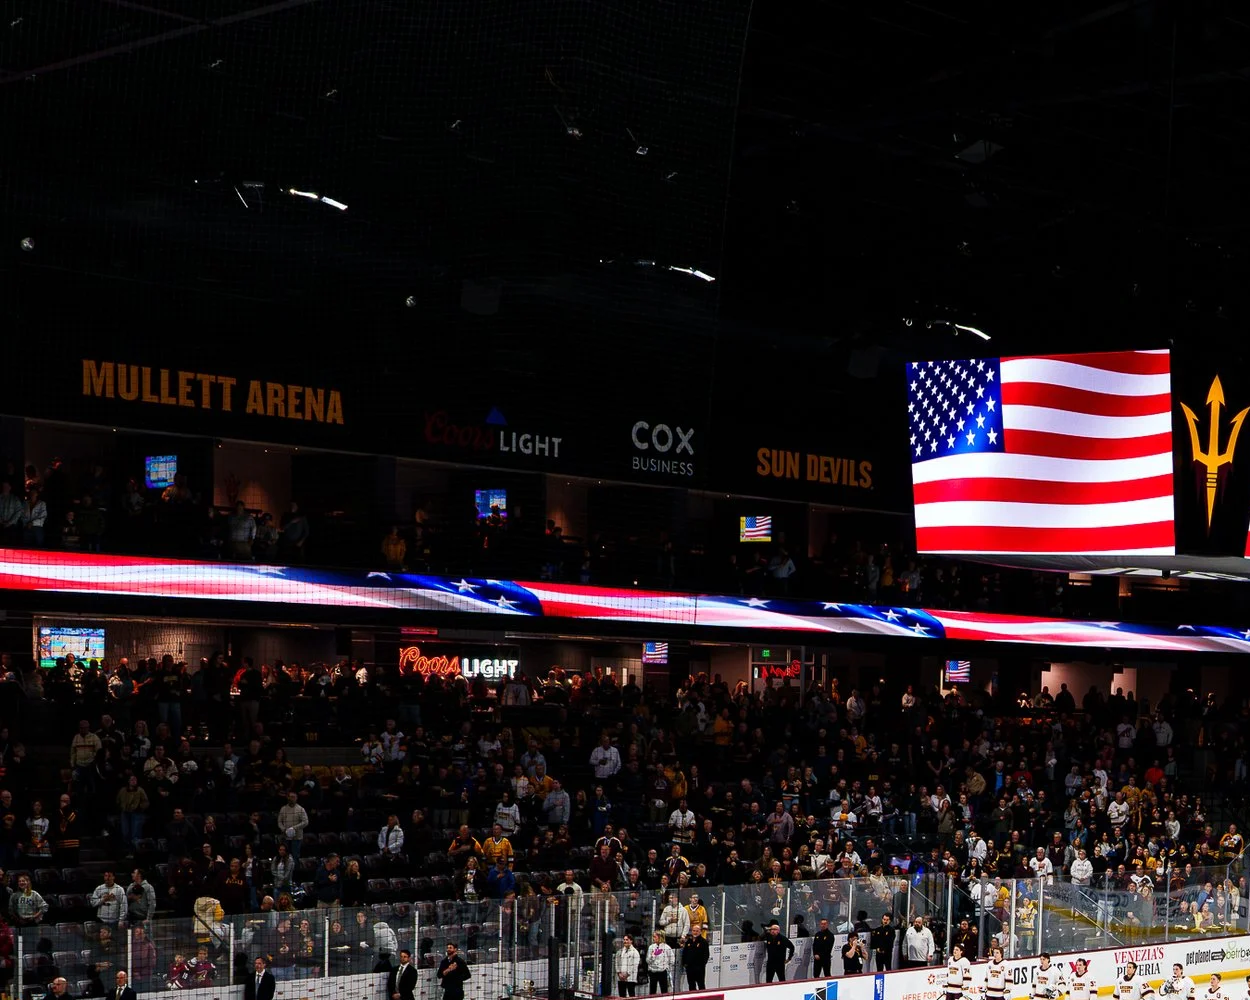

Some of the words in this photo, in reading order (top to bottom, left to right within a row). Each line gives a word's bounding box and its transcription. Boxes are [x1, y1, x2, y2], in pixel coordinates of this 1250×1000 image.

[81, 358, 237, 412] MULLETT
[244, 379, 345, 425] ARENA
[421, 406, 495, 451] Coors
[499, 429, 562, 458] LIGHT
[631, 420, 695, 455] COX
[631, 456, 694, 476] BUSINESS
[756, 447, 801, 479] SUN
[806, 450, 873, 488] DEVILS
[399, 646, 461, 679] Coors
[462, 657, 519, 679] LIGHT
[1114, 946, 1165, 964] VENEZIA'S
